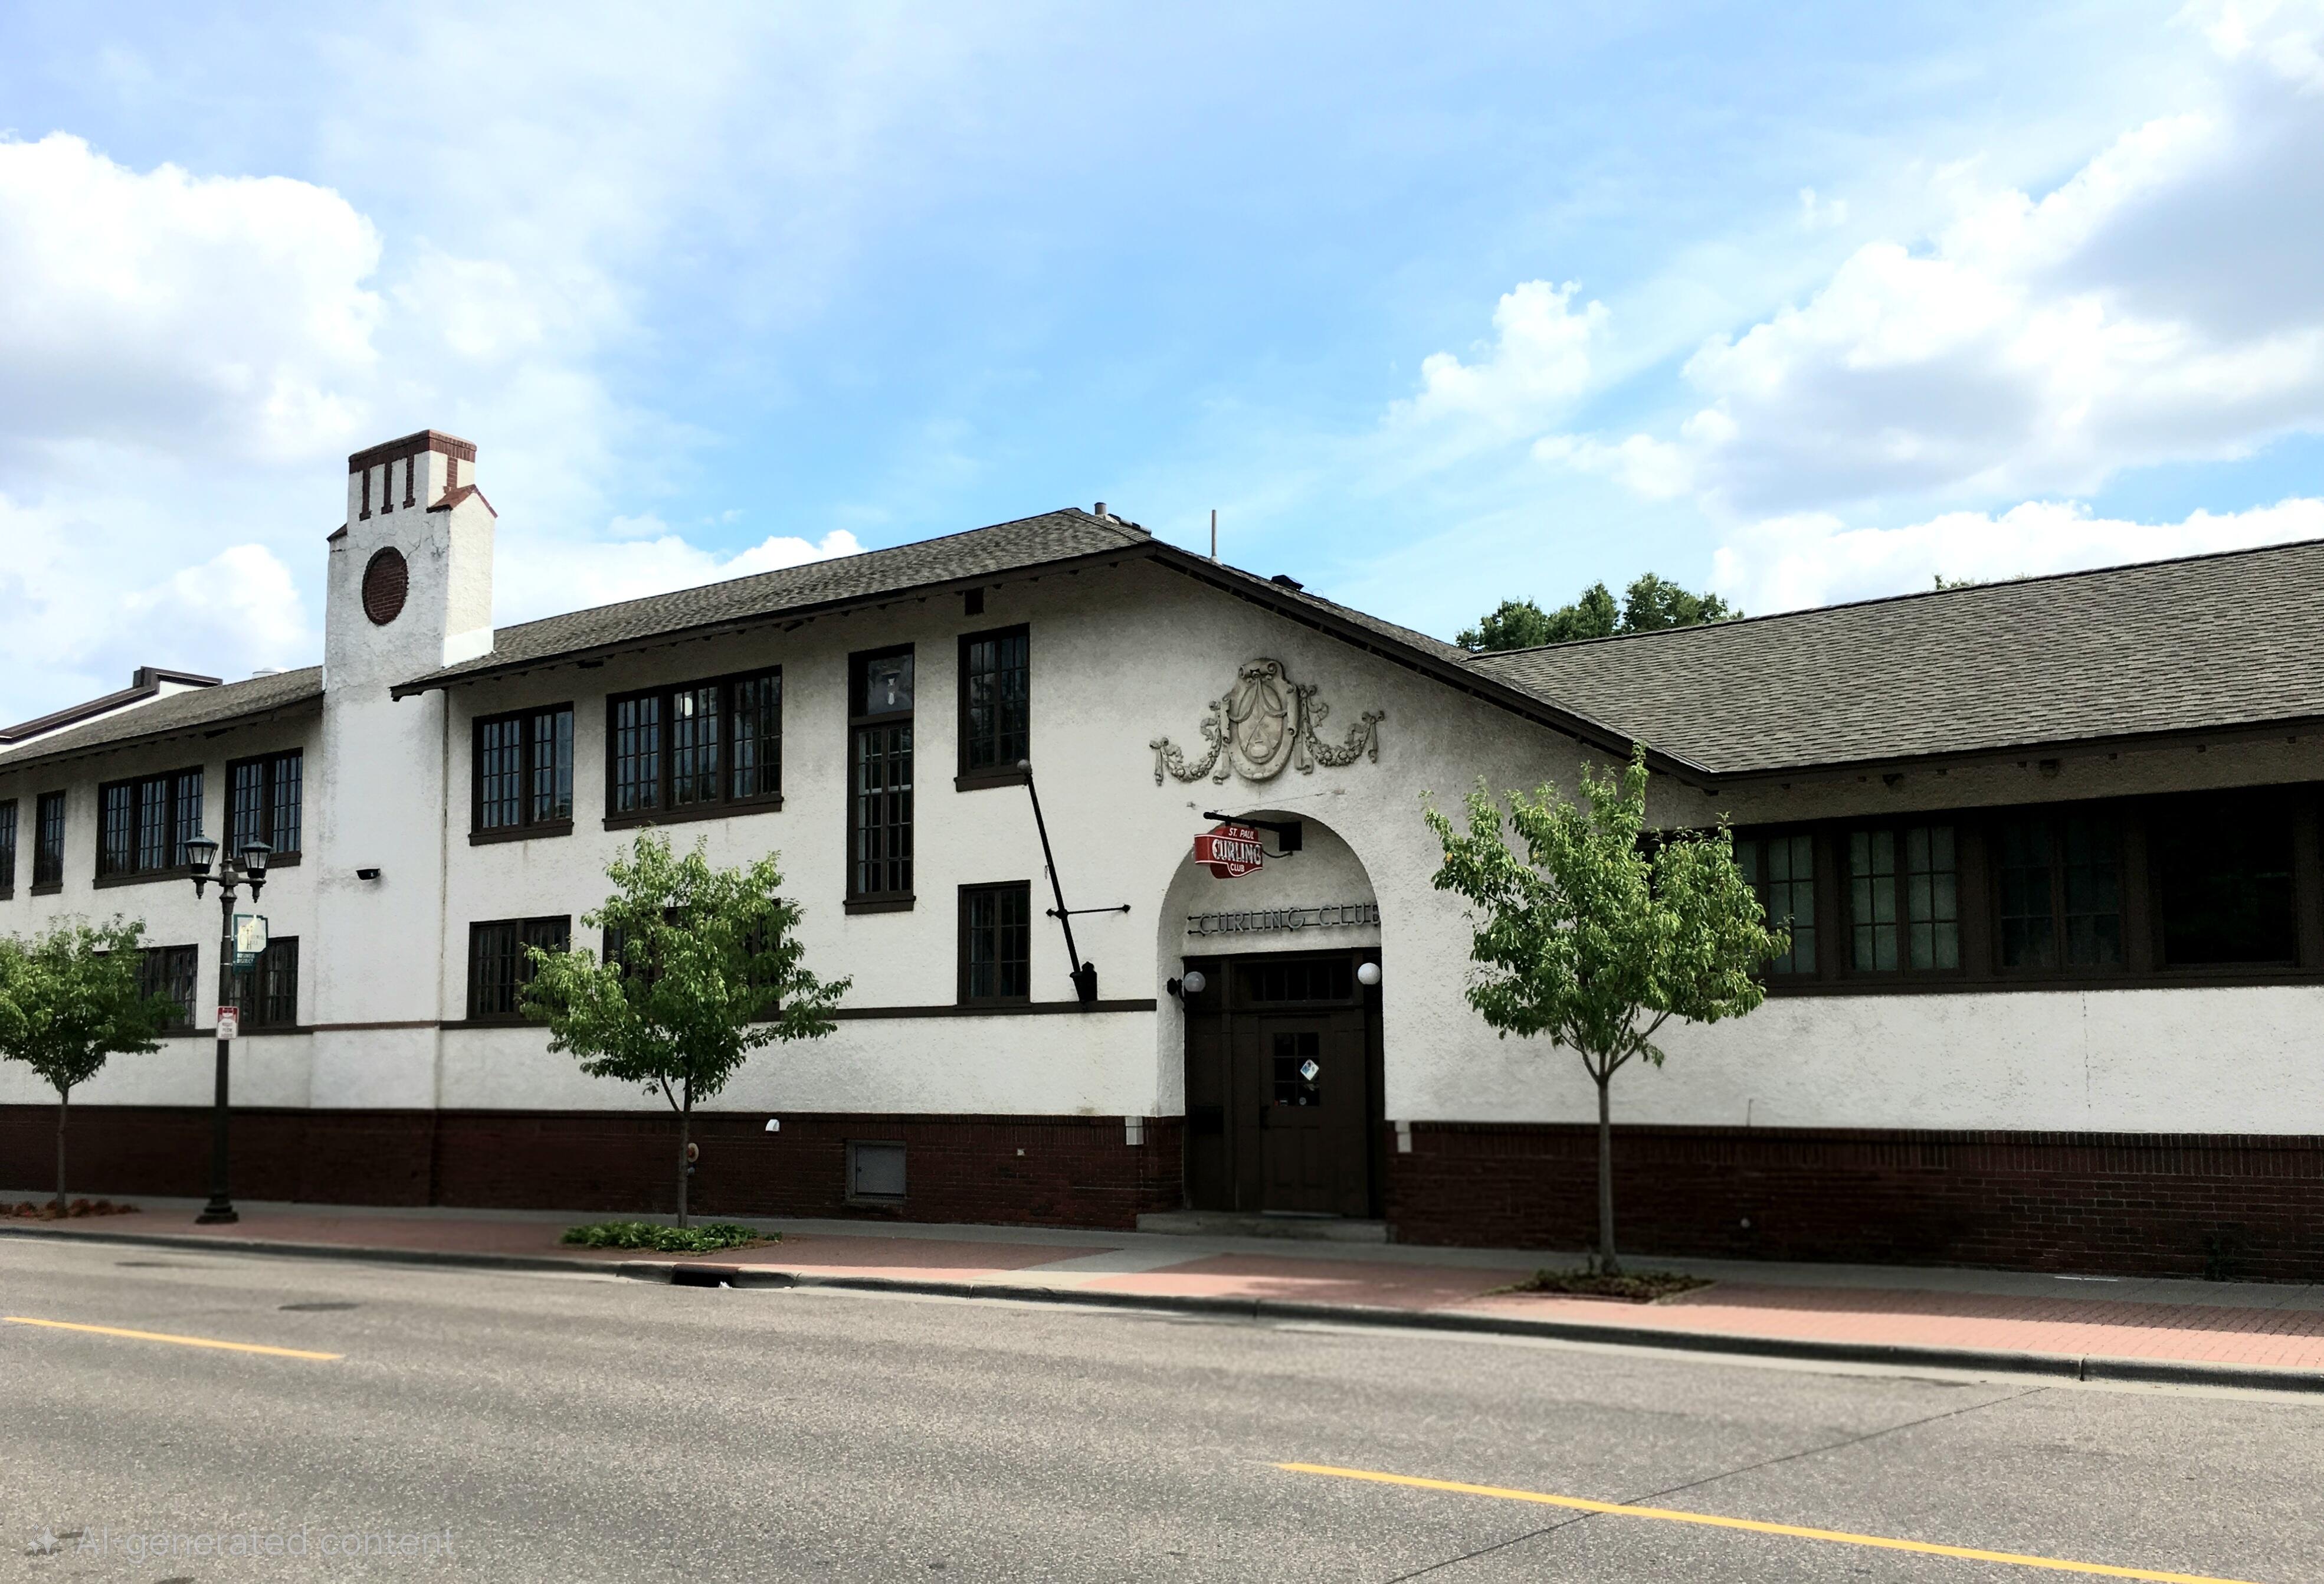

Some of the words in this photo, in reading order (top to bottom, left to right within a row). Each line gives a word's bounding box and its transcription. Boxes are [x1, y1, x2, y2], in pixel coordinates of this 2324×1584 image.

[1228, 827, 1238, 837] ST.
[1240, 829, 1254, 840] PAUL
[1212, 839, 1261, 865] CURLING
[1230, 863, 1245, 873] CLUB
[1199, 907, 1306, 934] CURLING
